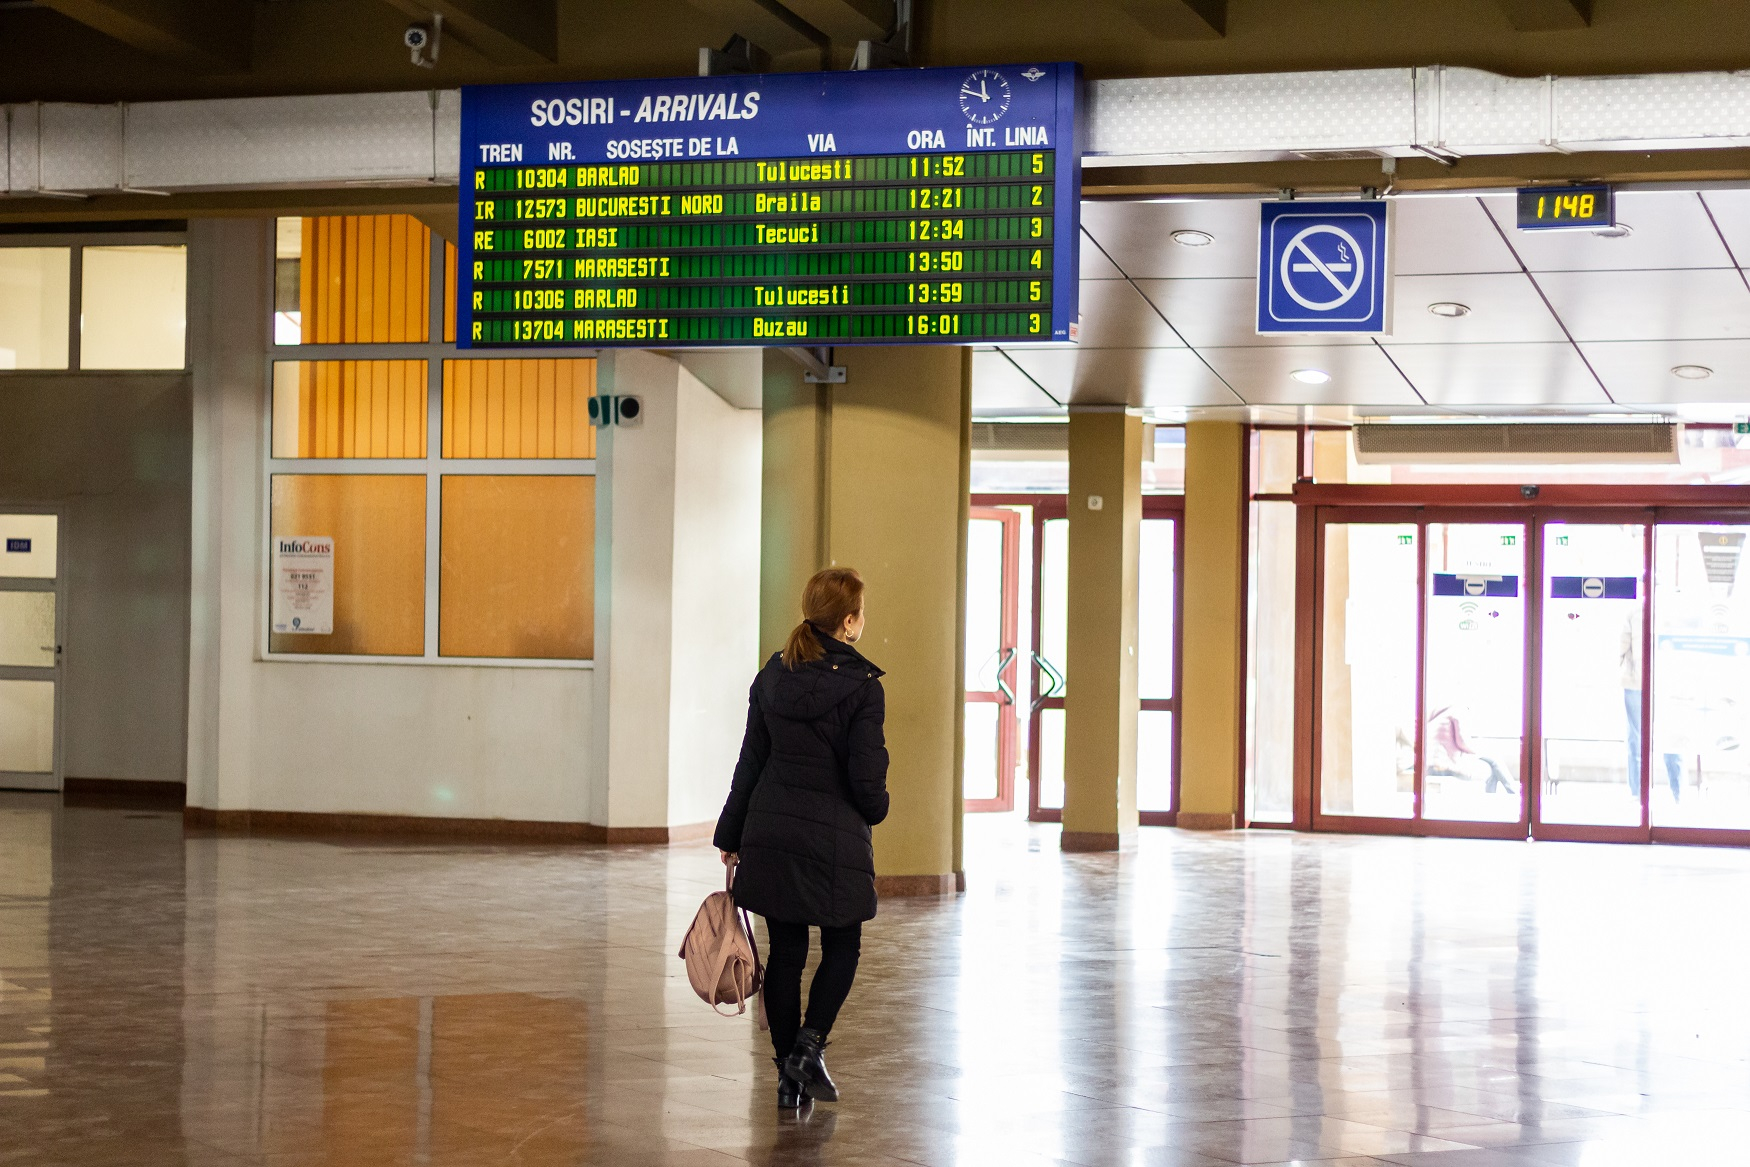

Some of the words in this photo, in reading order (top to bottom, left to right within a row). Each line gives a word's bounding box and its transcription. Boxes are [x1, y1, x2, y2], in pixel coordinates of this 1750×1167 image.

[530, 97, 614, 127] SOSIRI
[633, 91, 760, 123] ARRIVALS
[479, 143, 523, 163] TREN
[548, 141, 576, 161] NR.
[688, 137, 712, 157] DE
[716, 136, 739, 156] LA
[807, 133, 837, 153] VIA
[907, 129, 946, 150] ORA
[966, 124, 997, 147] ÎNT.
[1005, 125, 1049, 147] LINIA
[475, 171, 485, 190] R
[517, 168, 567, 189] 10304
[577, 166, 640, 187] BARLAD
[756, 159, 851, 182] Tulucesti
[910, 156, 965, 177] 11:52
[1032, 154, 1043, 174] 5
[475, 201, 495, 220] IR
[516, 198, 566, 219] 12573
[576, 196, 671, 217] BUCURESTI
[681, 194, 723, 215] NORD
[755, 192, 821, 213] Braila
[910, 188, 961, 209] 12:21
[1031, 186, 1043, 206] 2
[474, 231, 494, 250] RE
[524, 229, 566, 249] 6002
[575, 228, 618, 248] IASI
[755, 223, 818, 244] Tecuci
[909, 219, 964, 240] 12:34
[1031, 217, 1042, 237] 3
[473, 261, 484, 280] R
[523, 259, 563, 279] 7571
[575, 257, 670, 278] MARASESTI
[909, 251, 963, 272] 13:50
[1030, 249, 1042, 269] 4
[473, 291, 483, 310] R
[514, 289, 565, 310] 10306
[574, 288, 637, 309] BARLAD
[754, 285, 849, 306] Tulucesti
[908, 282, 962, 303] 13:59
[1029, 281, 1041, 301] 5
[472, 321, 482, 340] R
[514, 320, 564, 340] 13704
[574, 319, 668, 339] MARASESTI
[753, 317, 807, 337] Buzau
[907, 314, 958, 335] 16:01
[1029, 313, 1040, 333] 3
[280, 541, 330, 553] InfoCons
